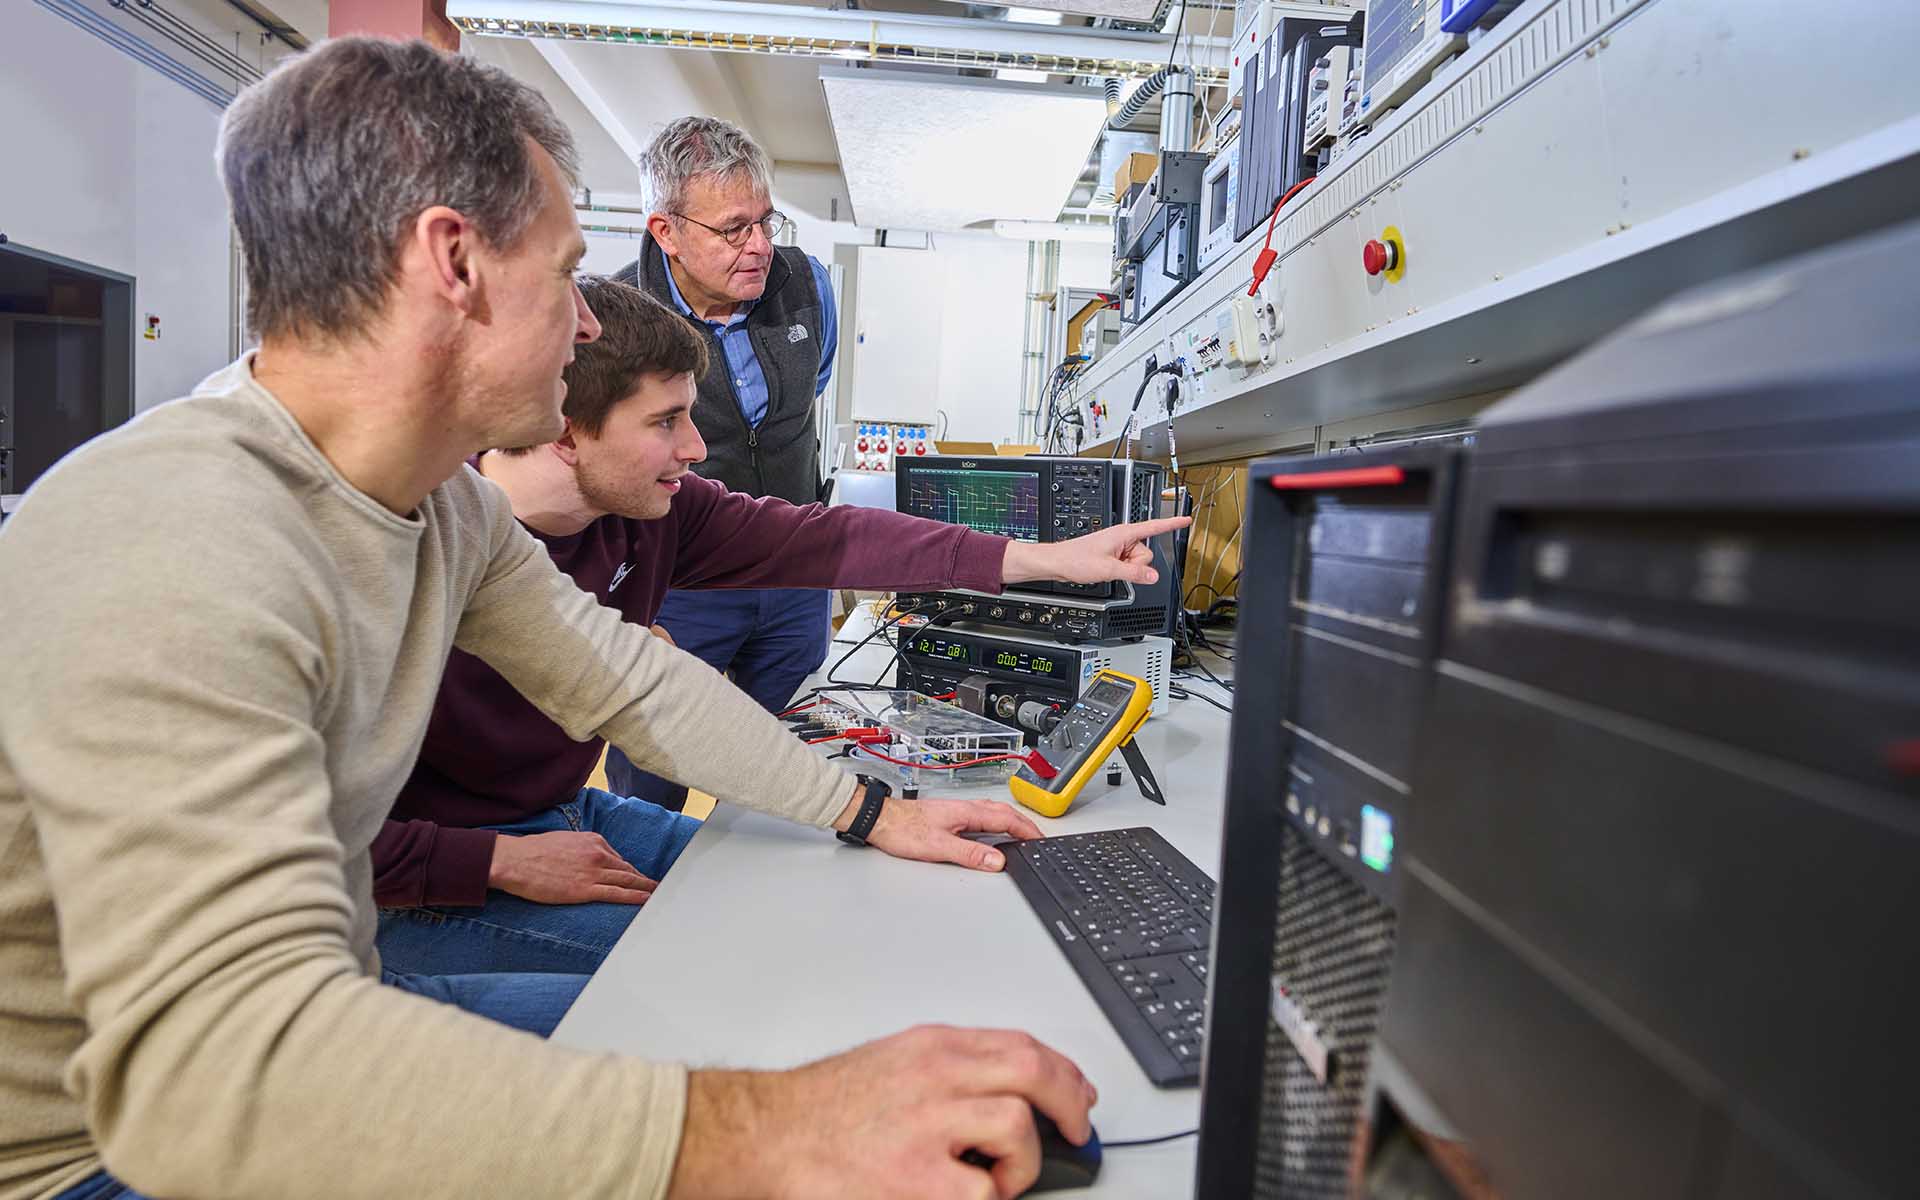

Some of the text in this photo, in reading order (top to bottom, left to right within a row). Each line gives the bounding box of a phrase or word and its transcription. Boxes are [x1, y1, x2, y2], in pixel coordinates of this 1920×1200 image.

[919, 641, 935, 653] 12.1
[947, 646, 966, 658] 0.81
[997, 653, 1017, 666] 00.0
[1031, 659, 1053, 673] 0.00
